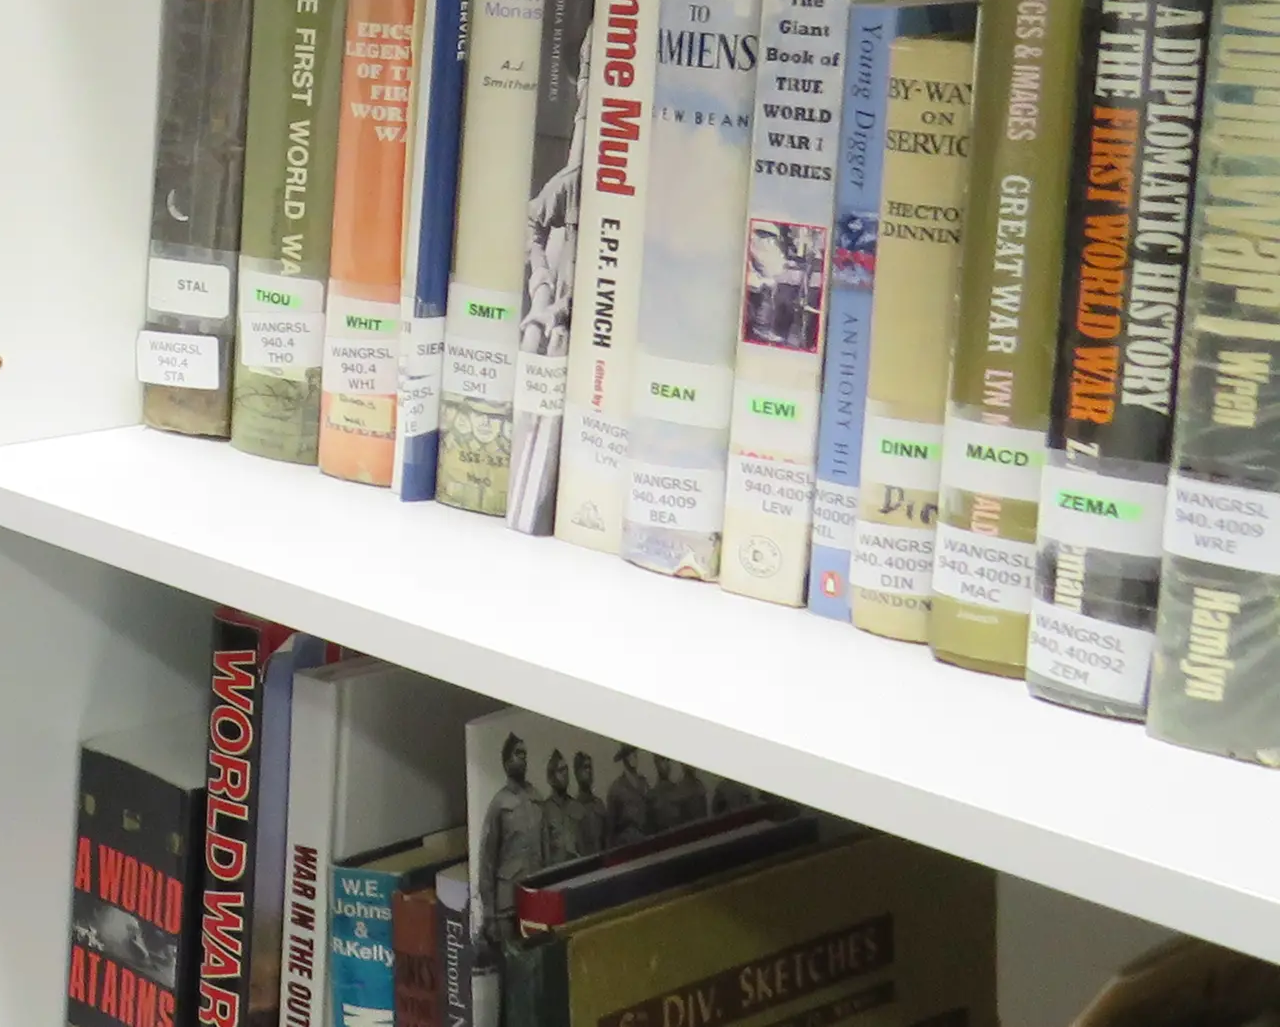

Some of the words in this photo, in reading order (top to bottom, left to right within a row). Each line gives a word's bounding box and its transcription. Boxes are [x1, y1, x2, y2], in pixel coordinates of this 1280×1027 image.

[689, 4, 710, 24] TO
[779, 20, 830, 38] Giant
[1155, 2, 1205, 29] A
[291, 27, 317, 107] FIRST
[356, 64, 384, 79] OF
[765, 47, 814, 65] Book
[820, 50, 840, 67] of
[852, 23, 883, 100] Young
[1013, 44, 1043, 60] &
[1094, 29, 1147, 98] THE
[763, 103, 833, 124] WORLD
[775, 76, 824, 94] TRUE
[1006, 64, 1041, 141] IMAGES
[694, 110, 750, 128] BEAN
[767, 132, 811, 151] WAR
[921, 110, 956, 126] ON
[1133, 29, 1204, 254] DIPLOMATIC
[283, 120, 311, 221] WORLD
[595, 97, 643, 197] Mud
[755, 159, 833, 182] STORIES
[847, 109, 876, 193] Digger
[1085, 106, 1139, 211] FIRST
[597, 217, 621, 271] E.P.F.
[993, 174, 1032, 278] GREAT
[177, 279, 209, 294] STAL
[255, 289, 290, 306] THOU
[1076, 211, 1133, 340] WORLD
[345, 315, 382, 331] WHIT
[468, 303, 506, 320] SMIT
[592, 277, 617, 350] LYNCH
[987, 282, 1023, 355] WAR
[1120, 257, 1185, 416] HISTORY
[650, 382, 696, 402] BEAN
[836, 314, 860, 431] ANTHONY
[1069, 345, 1121, 426] WAR
[1211, 350, 1273, 430] Wren
[966, 443, 1029, 468] MACD
[1058, 493, 1120, 519] ZEMA
[1179, 586, 1241, 702] Hamlyn
[205, 649, 257, 882] WORLD
[74, 835, 92, 895] A
[98, 844, 185, 935] WORLD
[291, 844, 318, 901] WAR
[340, 876, 385, 899] W.E.
[289, 901, 316, 933] IN
[333, 897, 393, 921] Johns
[68, 944, 101, 1008] AT
[102, 957, 176, 1027] ARMS
[197, 890, 245, 1027] WAR
[287, 934, 315, 982] THE
[445, 919, 466, 1009] Edmond
[663, 989, 727, 1027] DIV.
[740, 924, 882, 1012] SKETCHES
